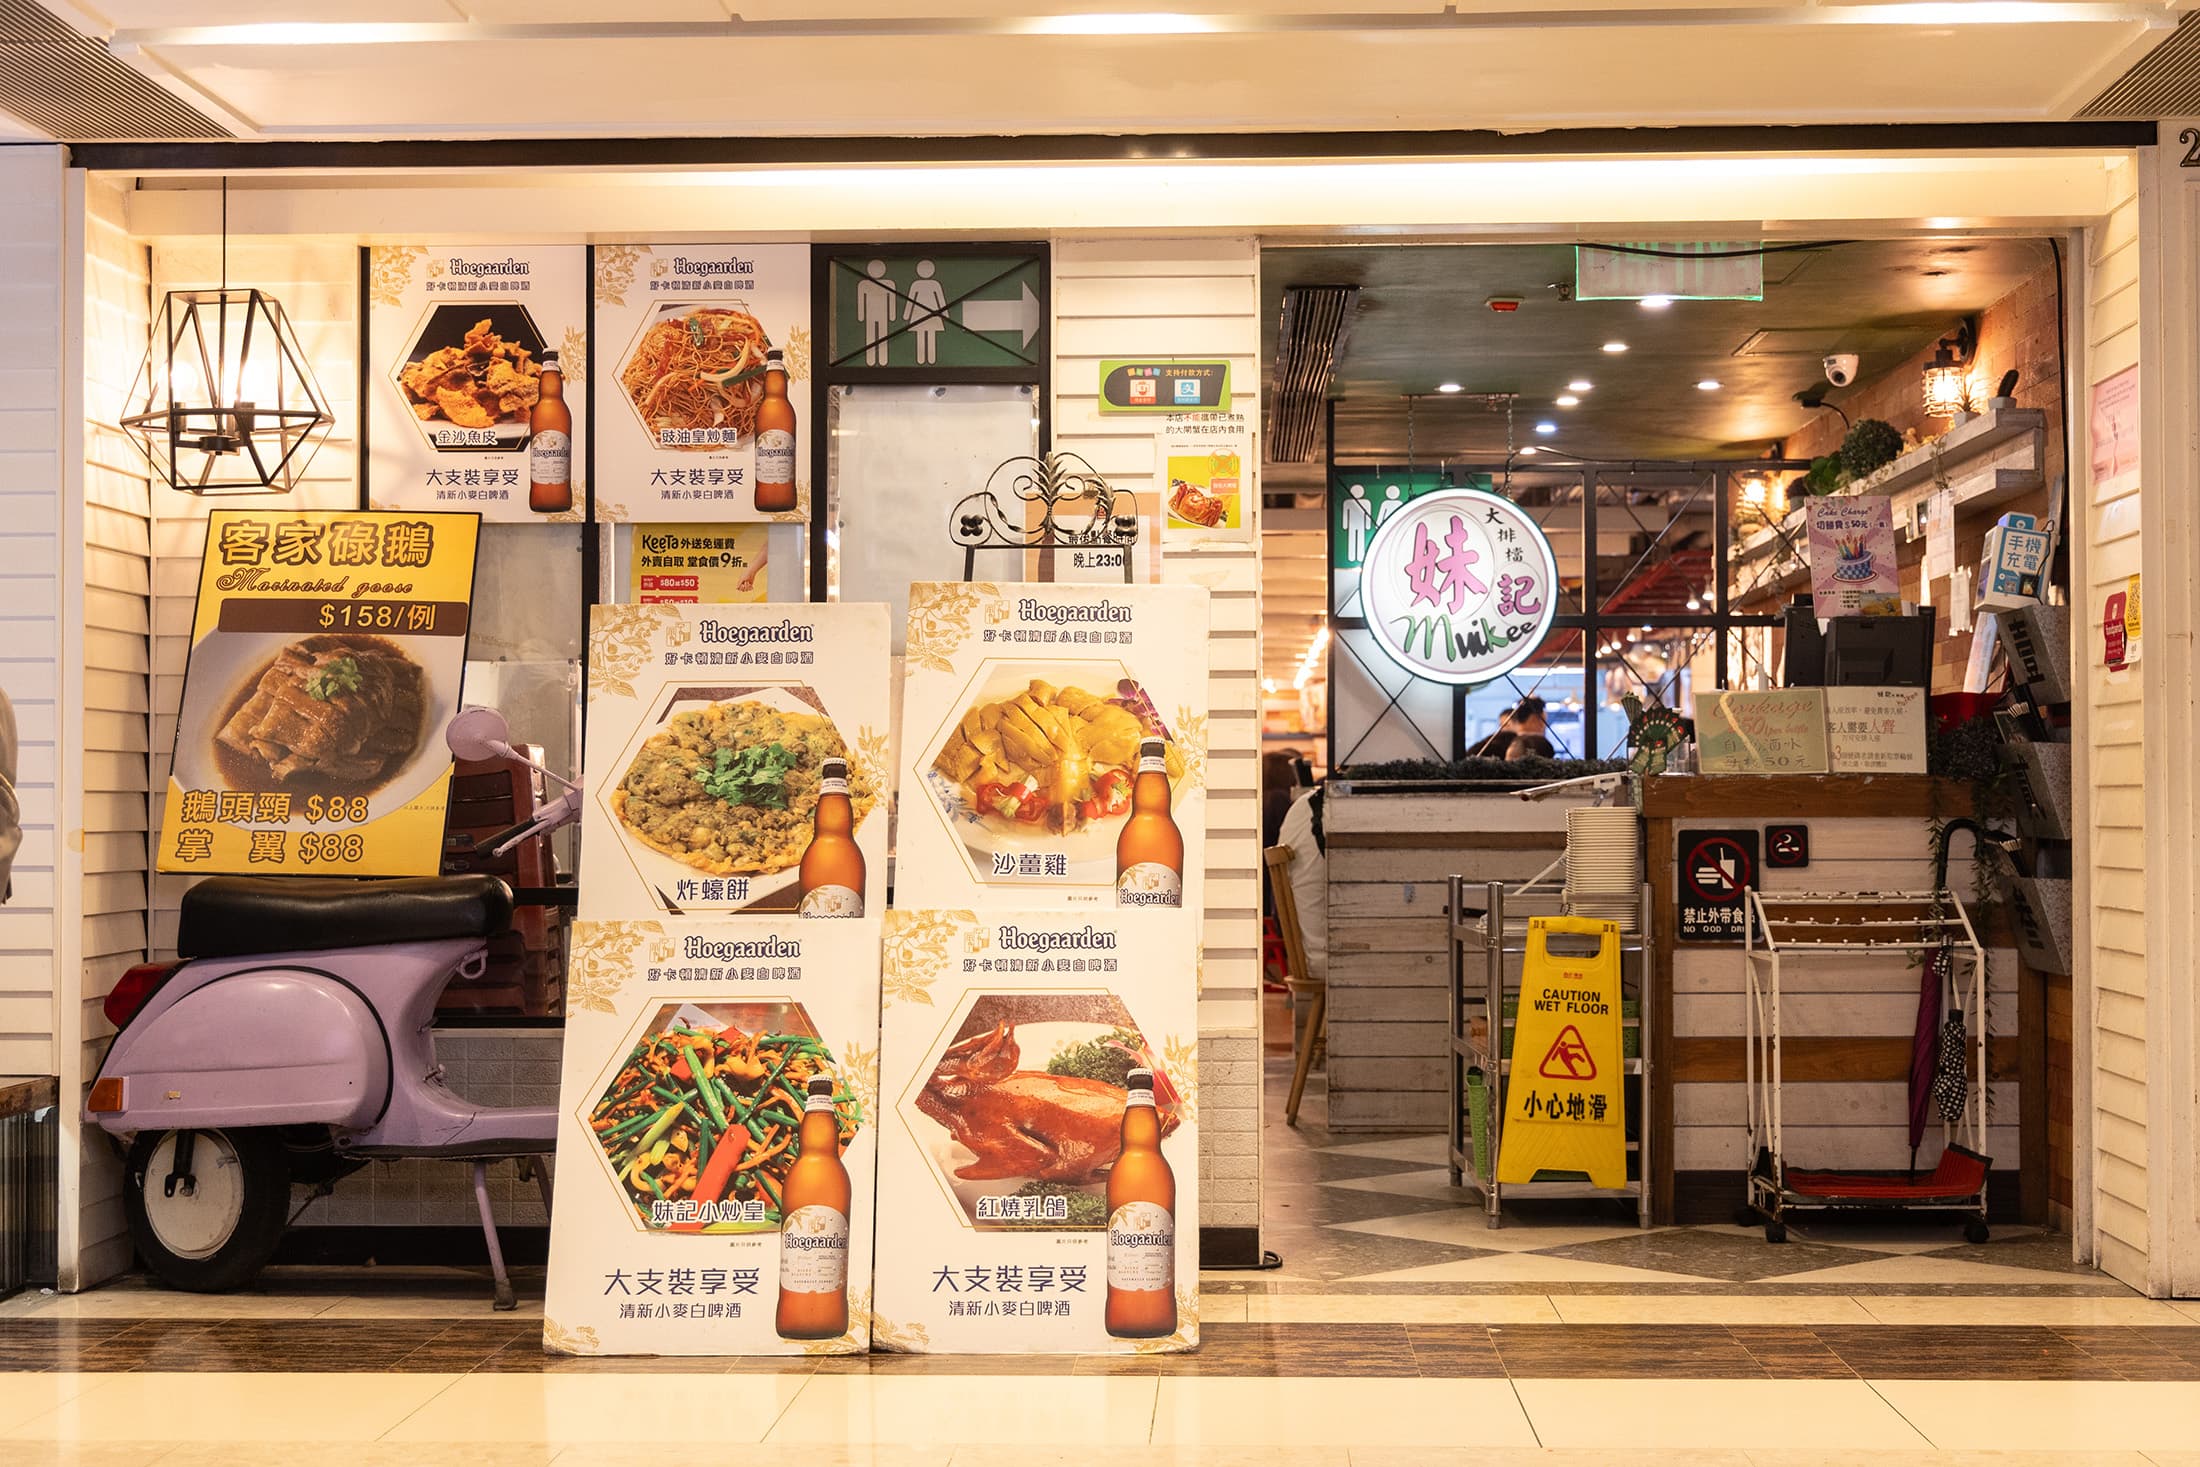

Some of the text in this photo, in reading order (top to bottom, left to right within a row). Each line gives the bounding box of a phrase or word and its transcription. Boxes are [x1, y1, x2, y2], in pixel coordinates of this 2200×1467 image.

[450, 258, 530, 278] Hoegaarden
[674, 257, 752, 277] Hoegaarden
[438, 430, 497, 444] 金沙魚皮
[662, 430, 737, 443] 豉油皇炒麵
[426, 469, 519, 486] 大支裝享受
[651, 468, 744, 486] 大支裝享受
[436, 490, 509, 500] 清新小麥白啤酒
[661, 490, 734, 500] 清新小麥白啤酒
[219, 520, 434, 567] 客家碌鵝
[2008, 535, 2042, 554] 手機
[1073, 552, 1125, 568] 晚上23:0
[2007, 552, 2038, 571] 充電
[351, 581, 413, 599] goose
[319, 603, 436, 631] $158/例
[1019, 599, 1132, 625] Hoegaarden
[700, 619, 814, 646] Hoegaarden
[1725, 738, 1802, 752] 自酒水
[181, 790, 369, 824] 鵝頭頸 $88
[175, 829, 364, 864] 掌 翼 $88
[994, 853, 1067, 875] 沙薑雞
[677, 879, 749, 900] 炸蠔餅
[1684, 907, 1755, 924] 禁止外带食
[685, 935, 800, 962] Hoegaarden
[999, 925, 1117, 953] Hoegaarden
[1543, 988, 1601, 1002] CAUTION
[1534, 1000, 1609, 1015] WET FLOOR
[1524, 1091, 1608, 1122] 小心地滑
[653, 1201, 765, 1222] 妹記小炒皇
[979, 1198, 1066, 1217] 紅燒乳鴿
[604, 1268, 760, 1295] 大支裝享受
[932, 1265, 1088, 1293] 大支裝享受
[619, 1303, 742, 1319] 清新小麥白啤酒
[949, 1300, 1071, 1317] 清新小麥白啤酒
